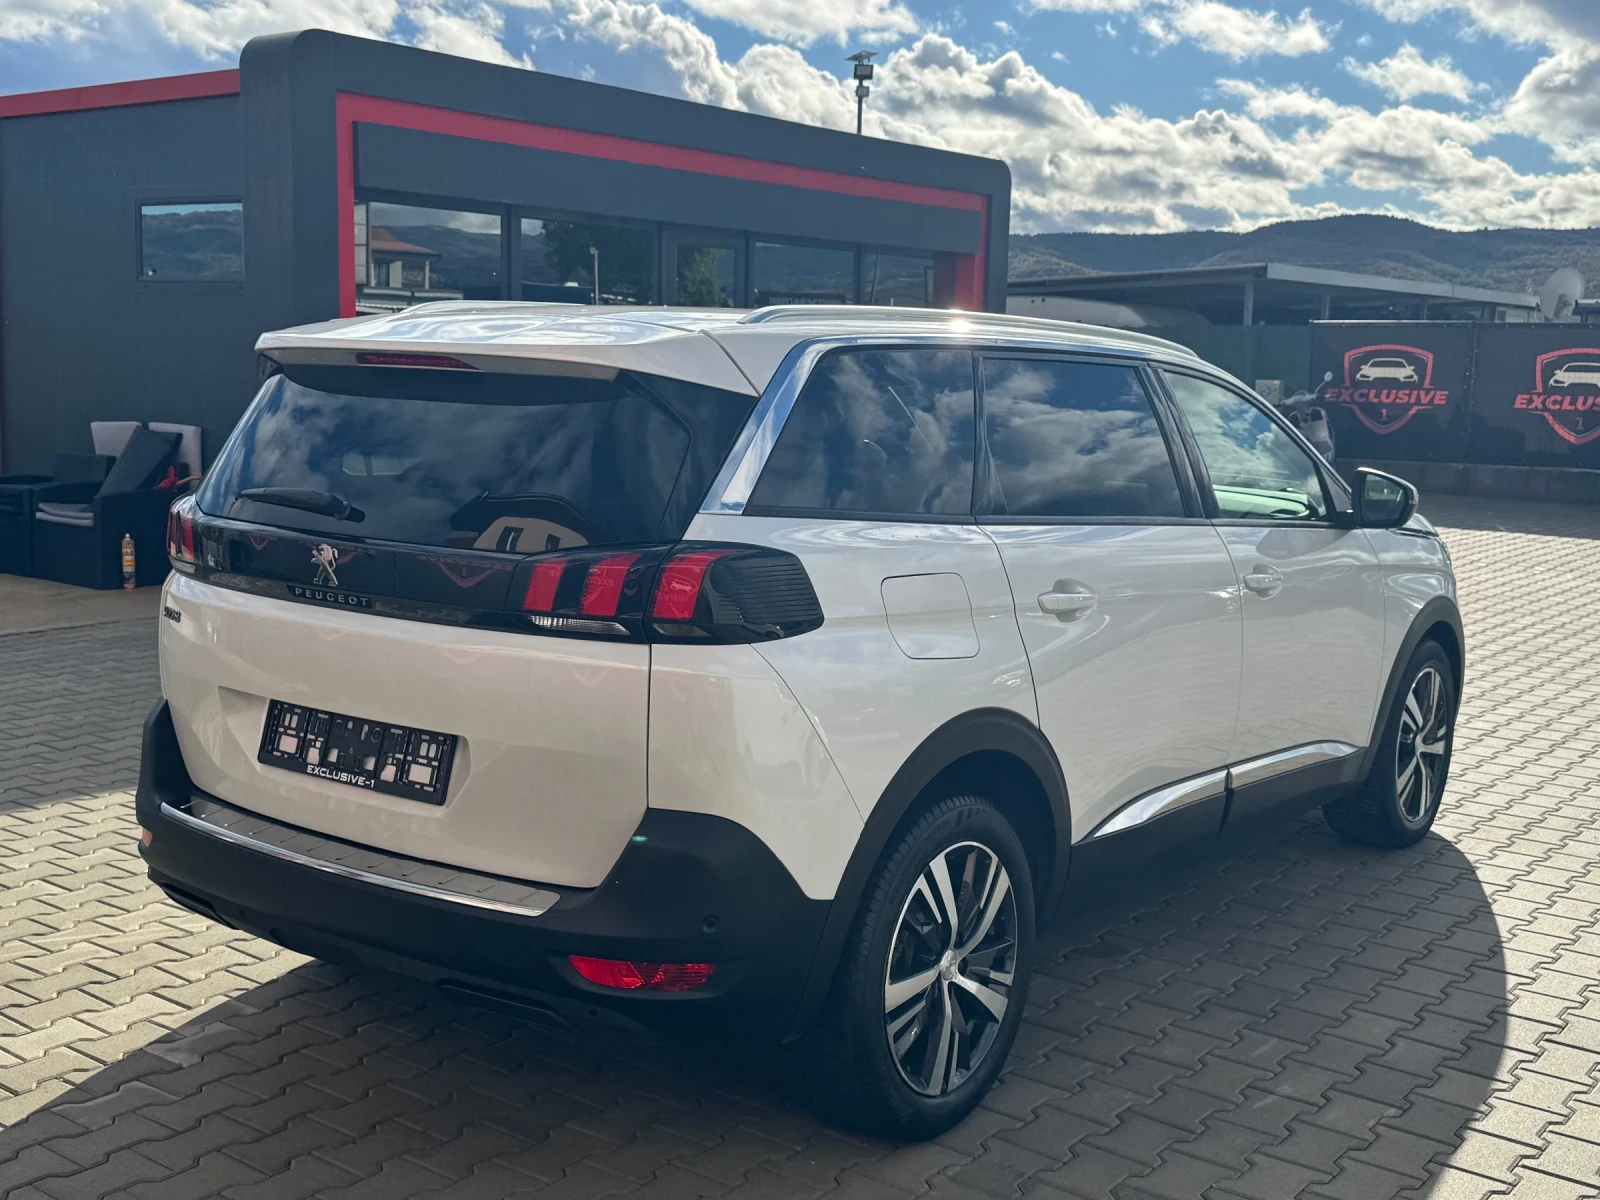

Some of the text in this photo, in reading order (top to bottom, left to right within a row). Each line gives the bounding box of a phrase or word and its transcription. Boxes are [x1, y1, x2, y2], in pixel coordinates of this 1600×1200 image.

[1325, 388, 1449, 405] EXCLUSIVE
[1380, 408, 1388, 421] 1
[1575, 416, 1584, 430] 1
[295, 587, 368, 606] PEUGEOT
[306, 764, 375, 788] EXCLUSIVE-1
